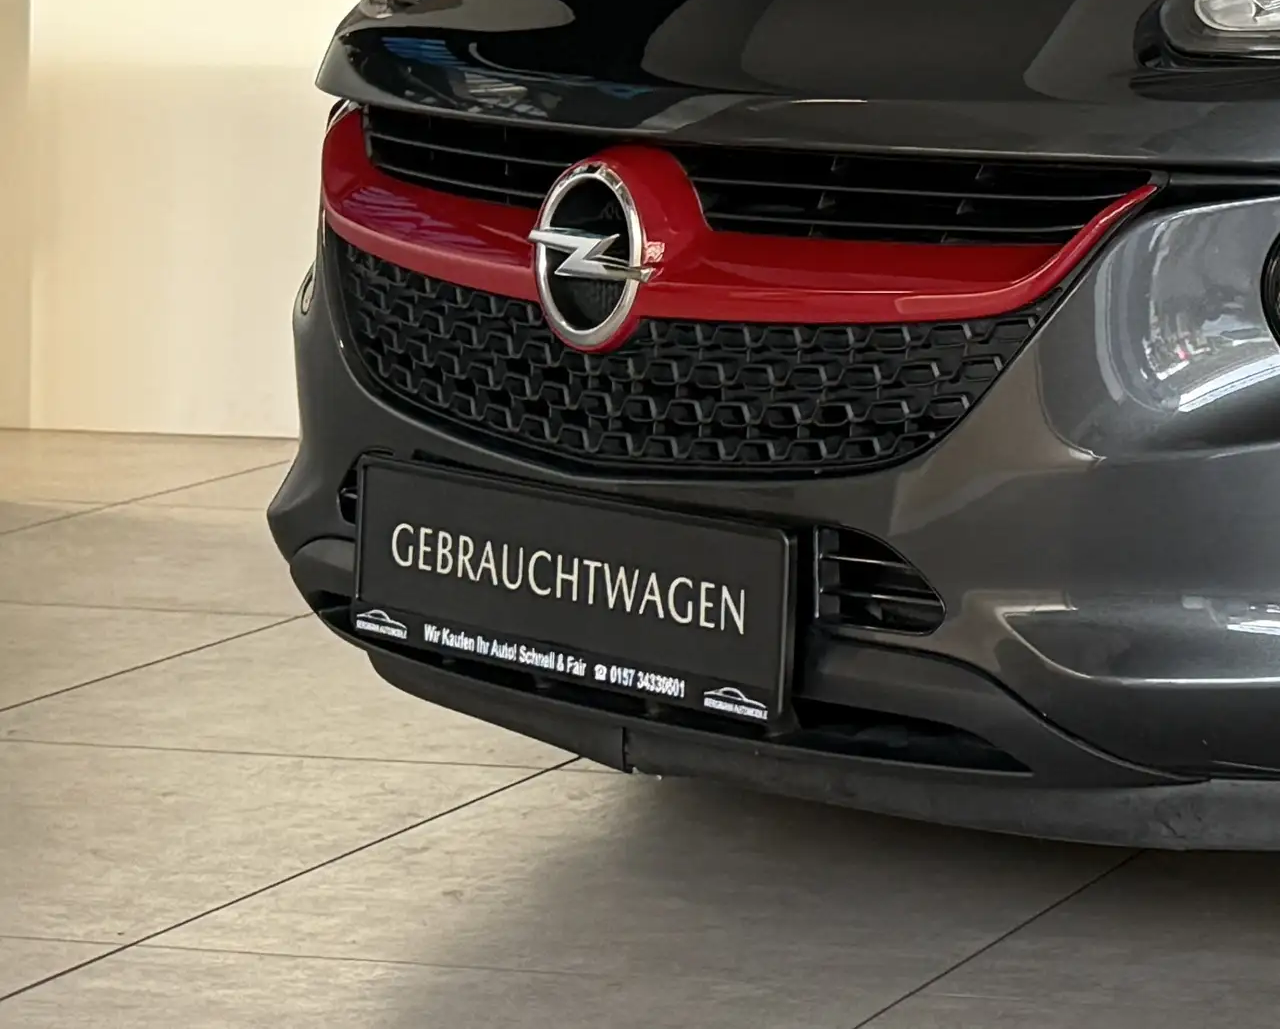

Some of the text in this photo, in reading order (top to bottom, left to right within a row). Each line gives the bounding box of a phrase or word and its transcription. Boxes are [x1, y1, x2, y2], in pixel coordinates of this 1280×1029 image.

[391, 522, 745, 635] GEBRAUCHTWAGEN
[424, 623, 441, 643] Wir
[441, 627, 475, 652] Kaufen
[476, 635, 489, 655] Ihr
[490, 639, 517, 662] Auto!
[519, 645, 555, 670] Schnell
[556, 653, 565, 672] &
[566, 655, 587, 677] Fair
[609, 664, 636, 687] 0157
